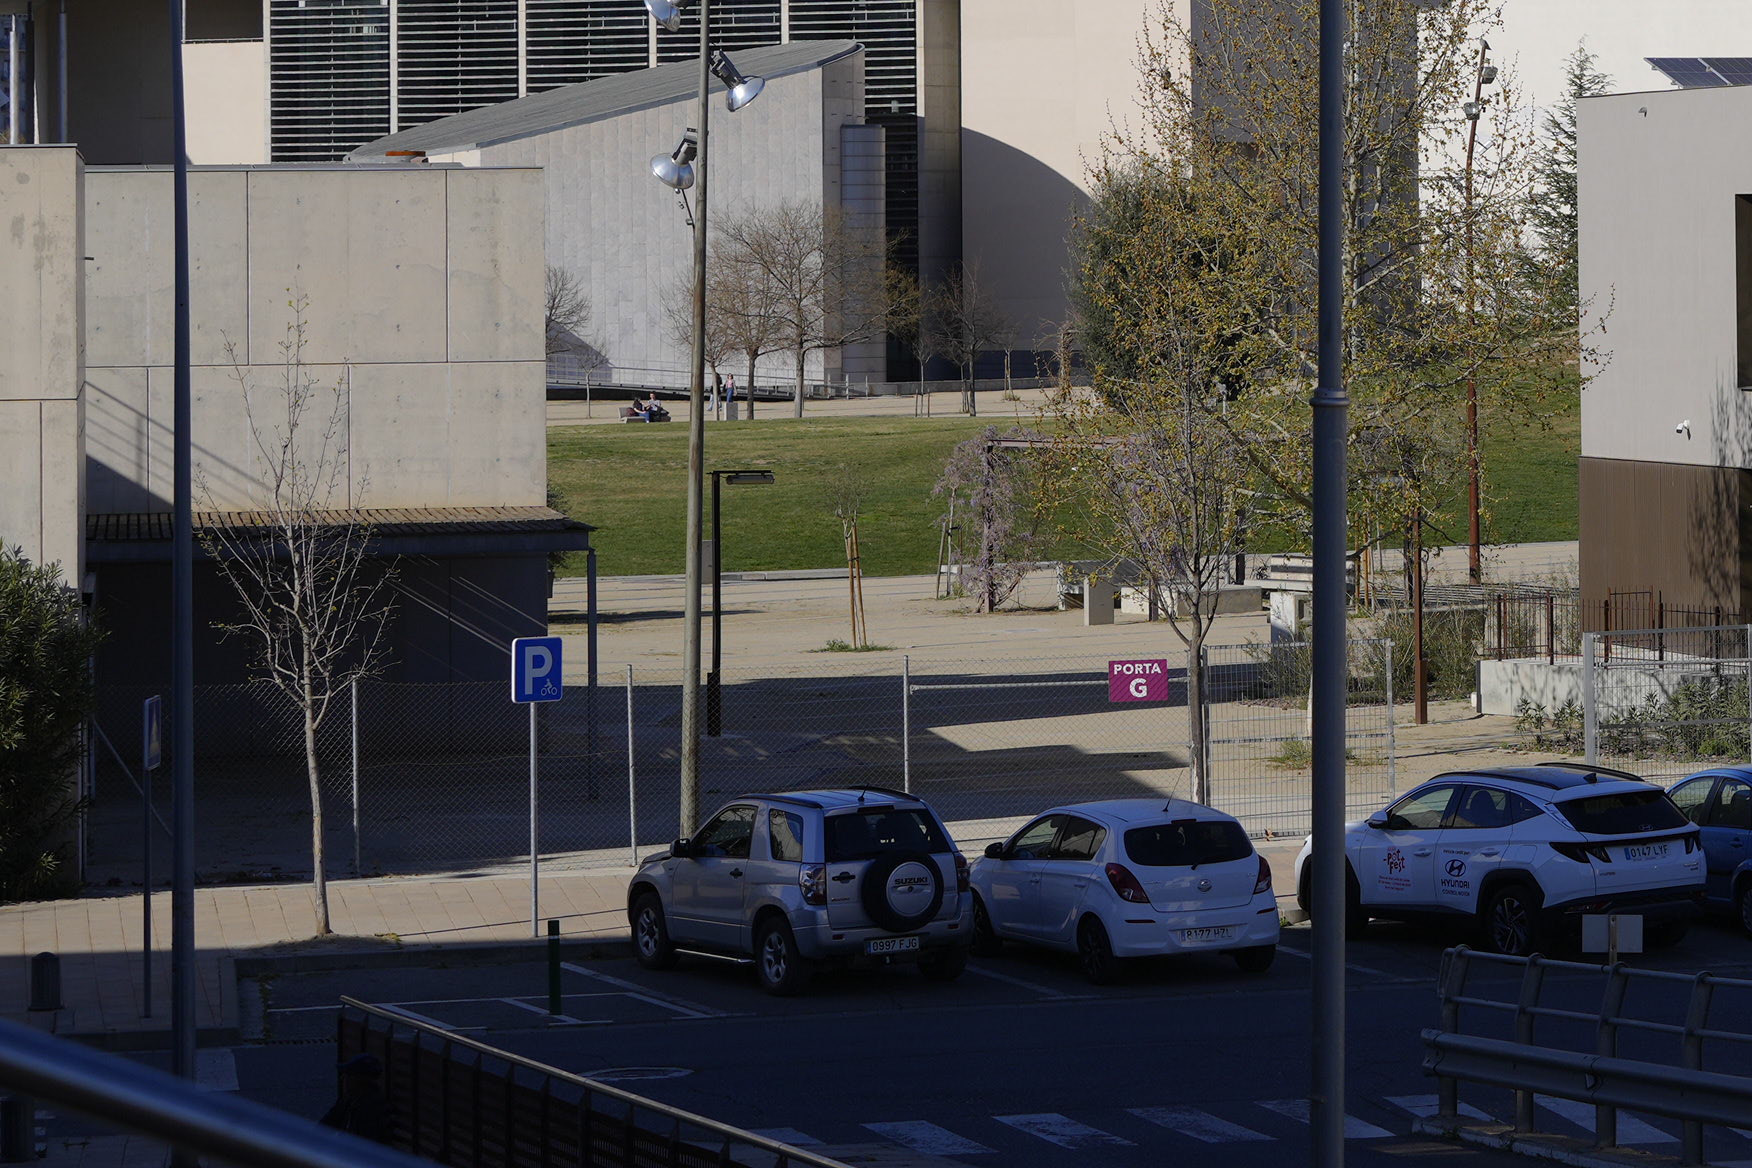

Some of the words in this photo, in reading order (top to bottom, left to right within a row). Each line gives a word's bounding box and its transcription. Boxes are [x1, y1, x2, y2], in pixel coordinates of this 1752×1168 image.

[524, 645, 553, 695] P
[1113, 662, 1162, 675] PORTA
[1129, 677, 1148, 698] G
[1630, 846, 1650, 858] 0147
[1653, 844, 1668, 856] LYF
[894, 876, 928, 885] SUZUKI
[1440, 878, 1470, 889] HYUNDAI
[1186, 928, 1211, 939] 8177
[1213, 927, 1232, 938] HZL
[872, 939, 896, 952] 0997
[899, 937, 917, 949] FJG
